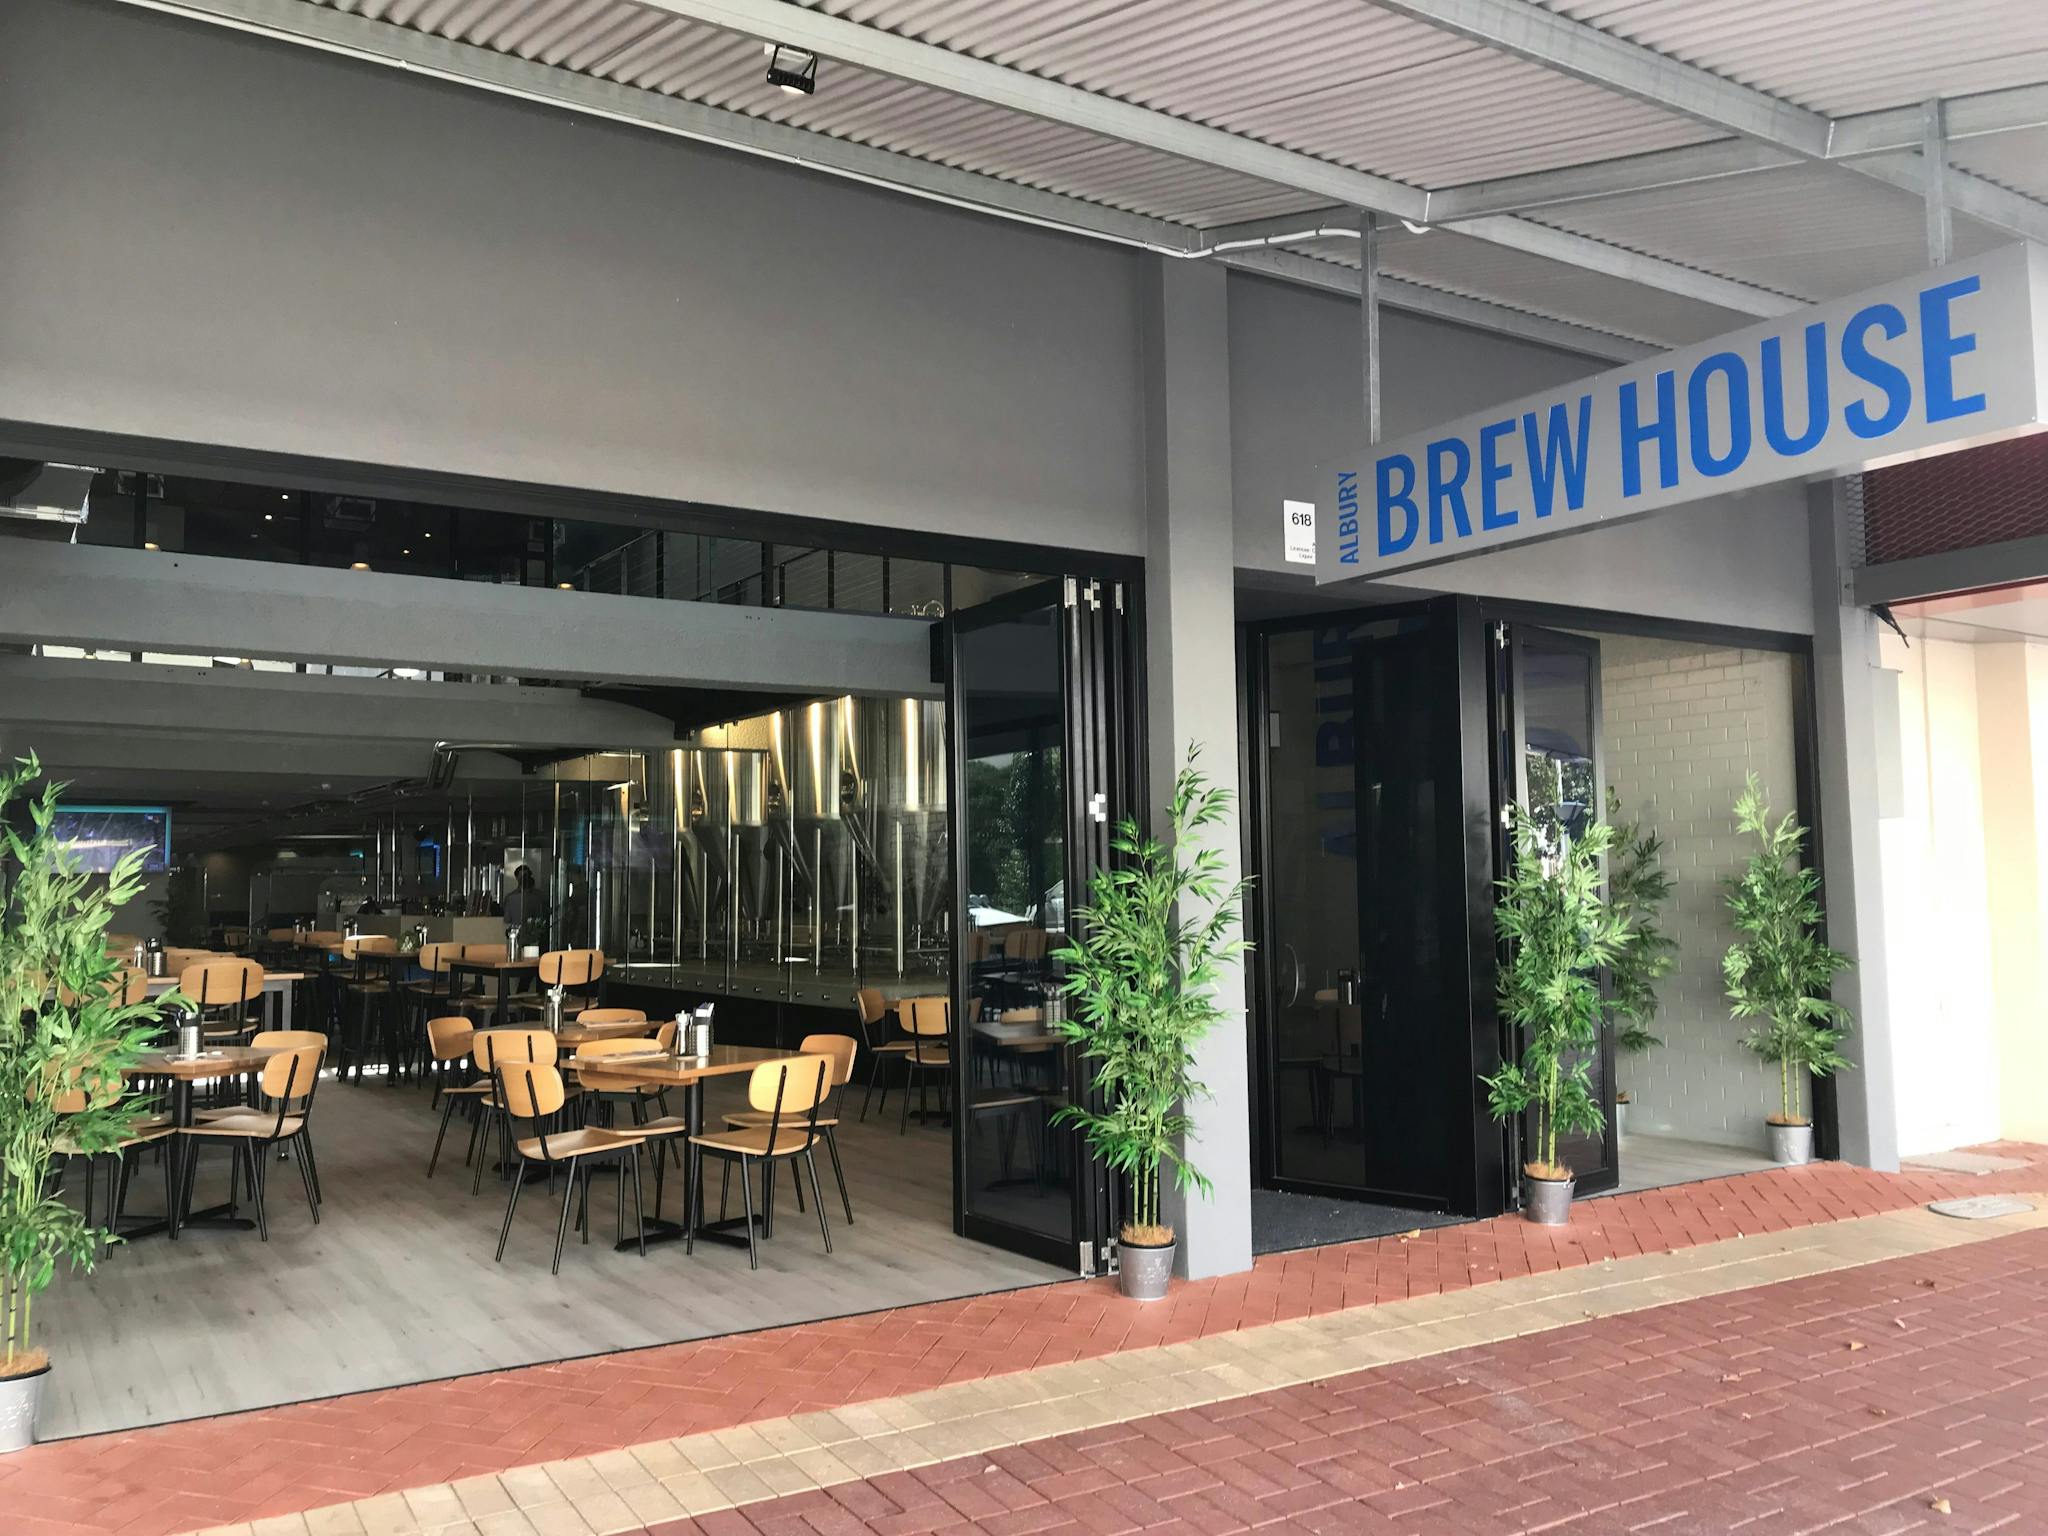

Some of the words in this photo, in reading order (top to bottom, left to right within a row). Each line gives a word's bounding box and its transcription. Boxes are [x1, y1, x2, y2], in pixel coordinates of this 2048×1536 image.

[1376, 395, 1592, 557] BREW
[1619, 275, 1986, 498] HOUSE
[1291, 512, 1312, 527] 618
[1338, 472, 1359, 564] ALBURY
